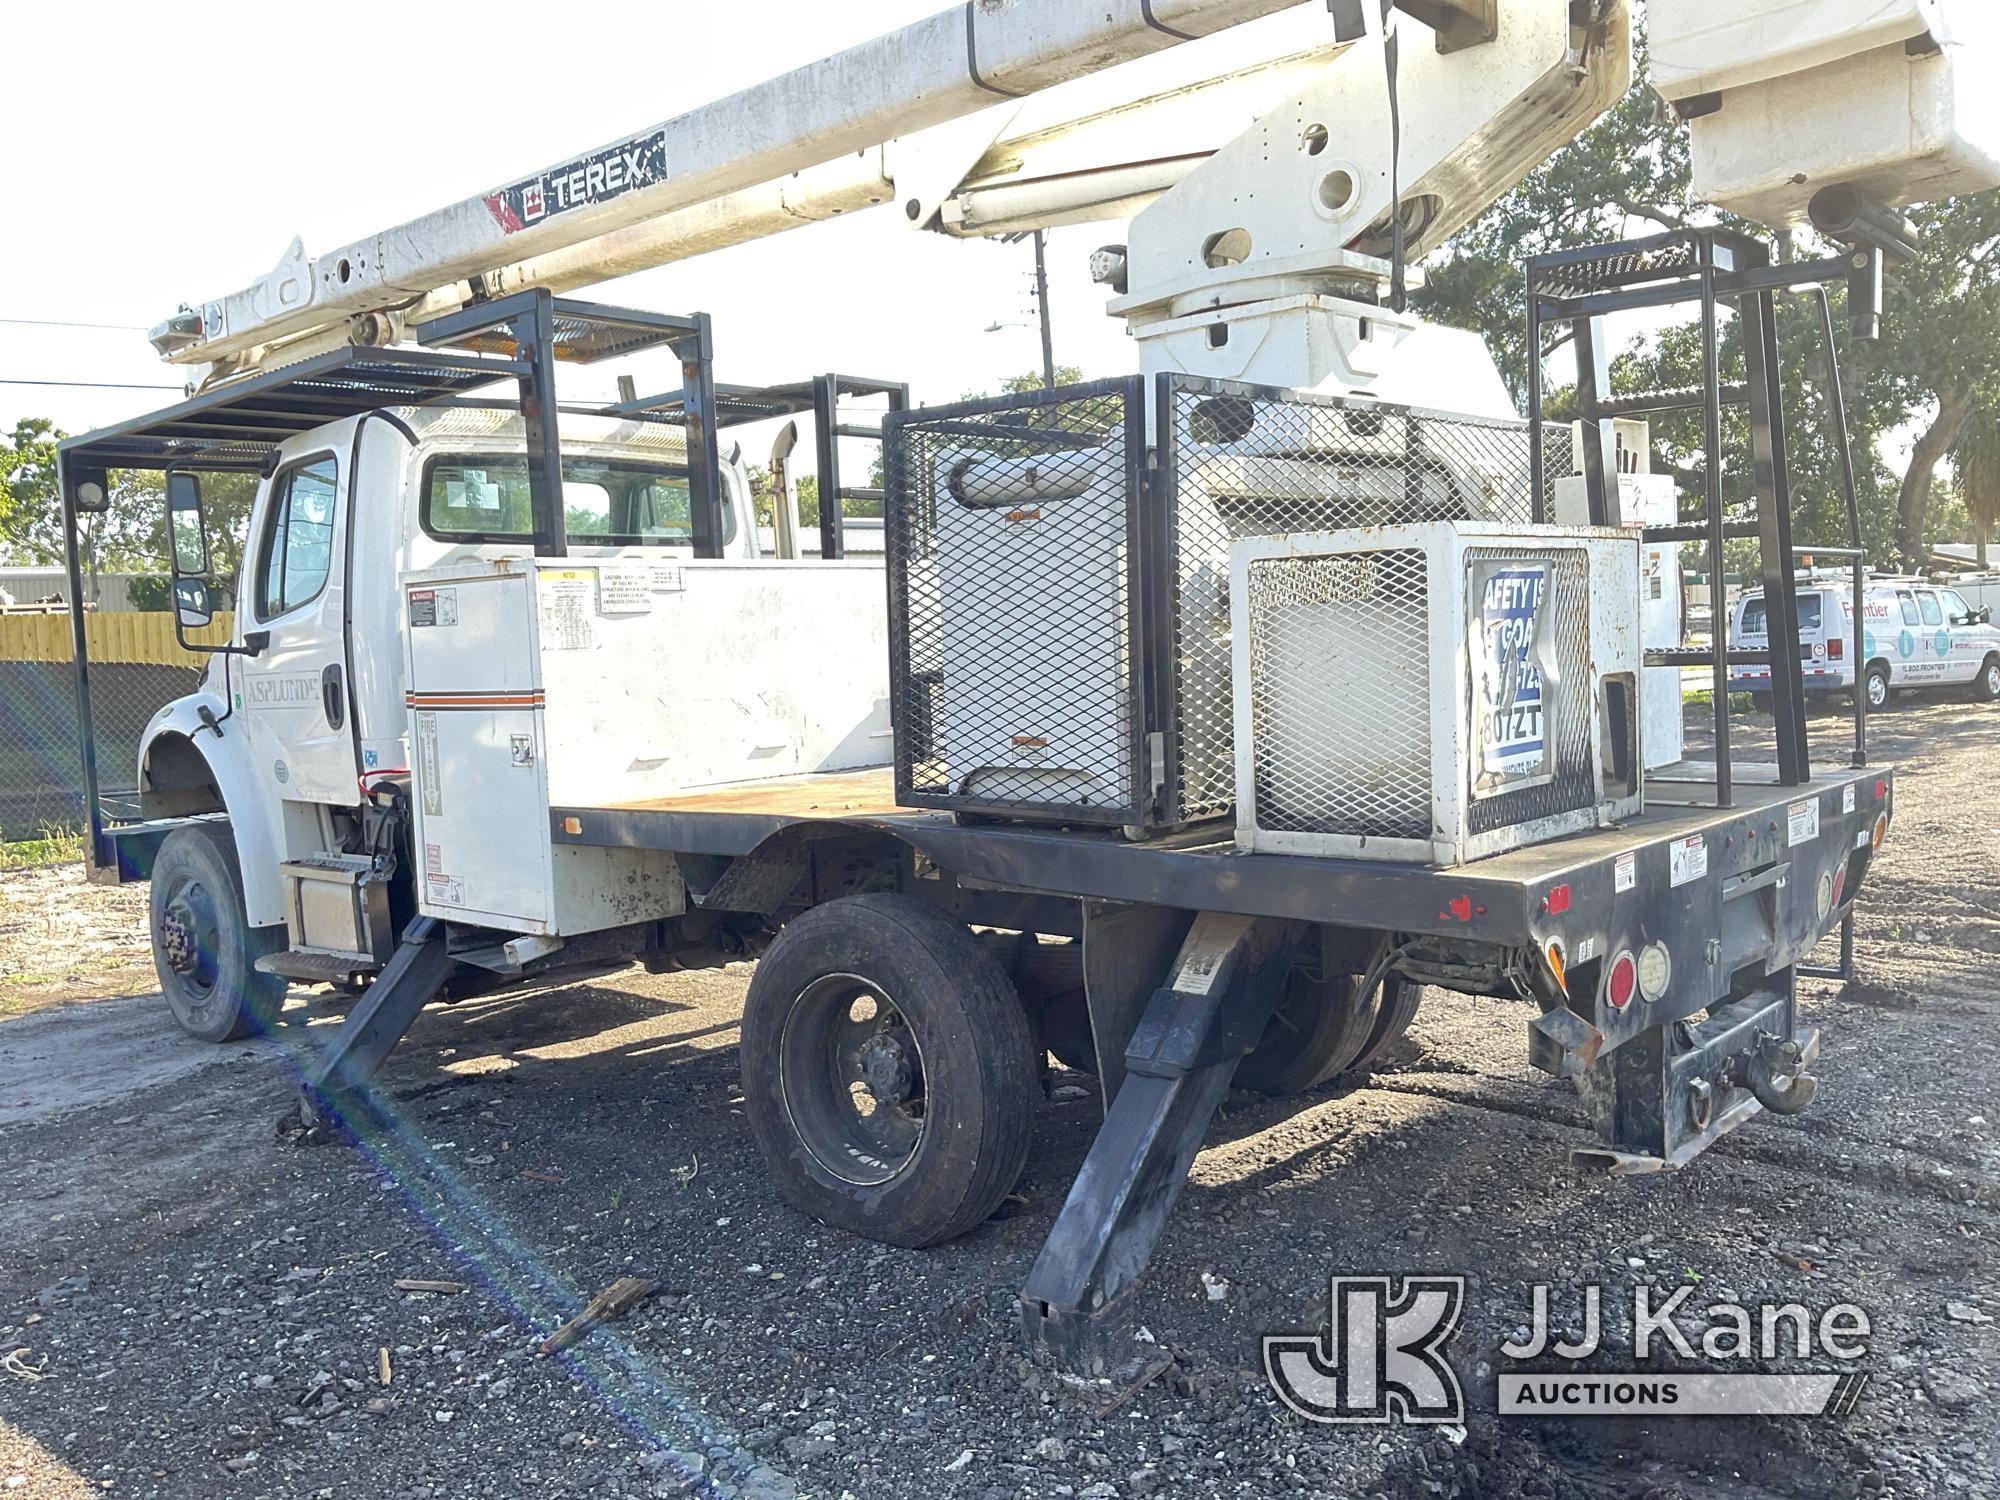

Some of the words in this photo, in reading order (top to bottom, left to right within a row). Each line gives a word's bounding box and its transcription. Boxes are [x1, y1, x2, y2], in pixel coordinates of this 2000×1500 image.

[551, 148, 645, 208] TEREX
[415, 592, 433, 600] DANGER
[1842, 602, 1888, 617] Frntier
[420, 720, 435, 734] FIRE
